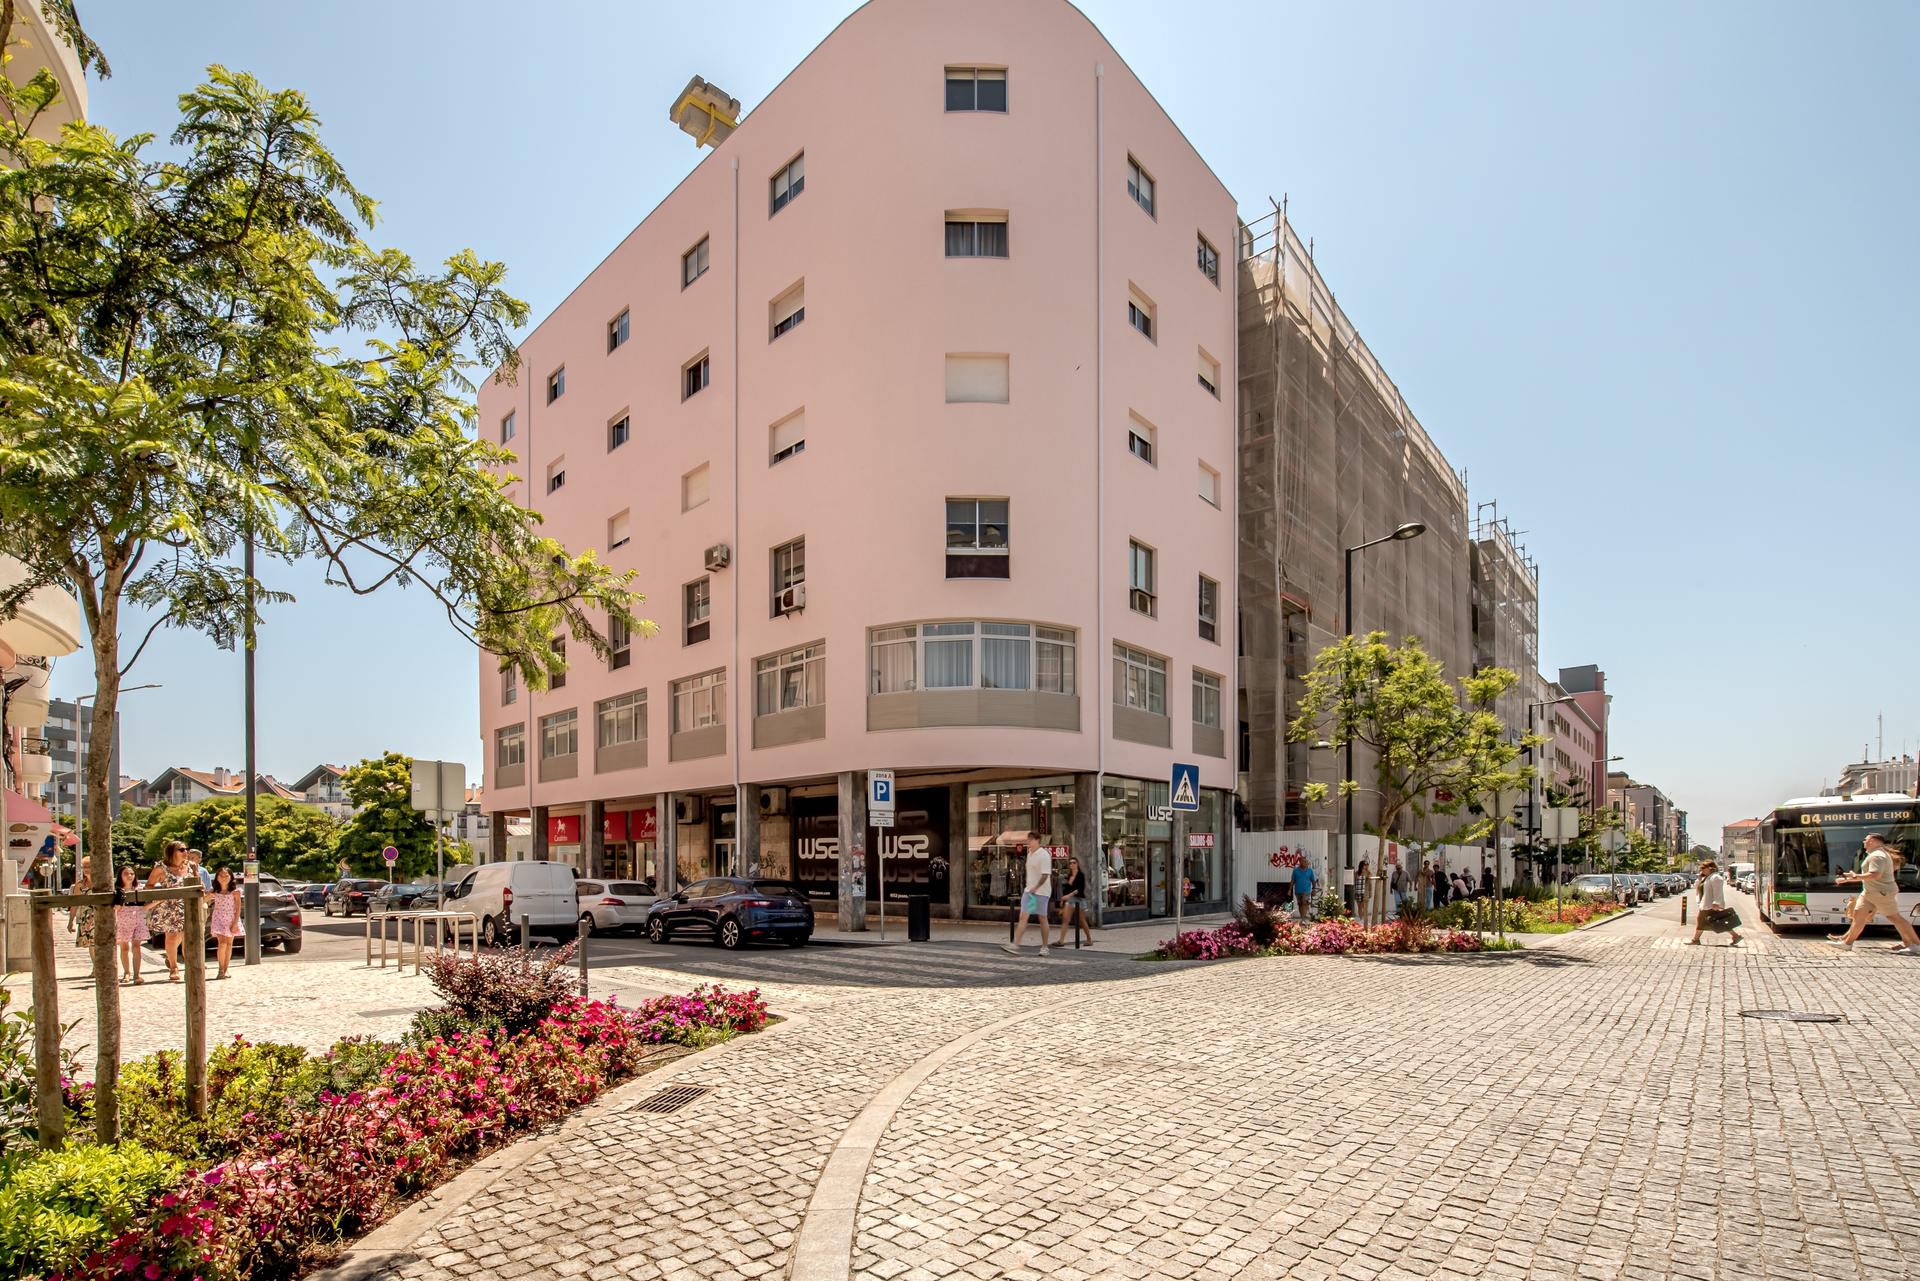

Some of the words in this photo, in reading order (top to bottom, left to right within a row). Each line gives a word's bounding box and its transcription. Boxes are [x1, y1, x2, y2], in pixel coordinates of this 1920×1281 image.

[876, 782, 887, 800] P
[1800, 813, 1821, 825] 04
[1824, 812, 1860, 821] MONTE
[1865, 812, 1879, 820] DE
[1883, 811, 1910, 819] EIXO
